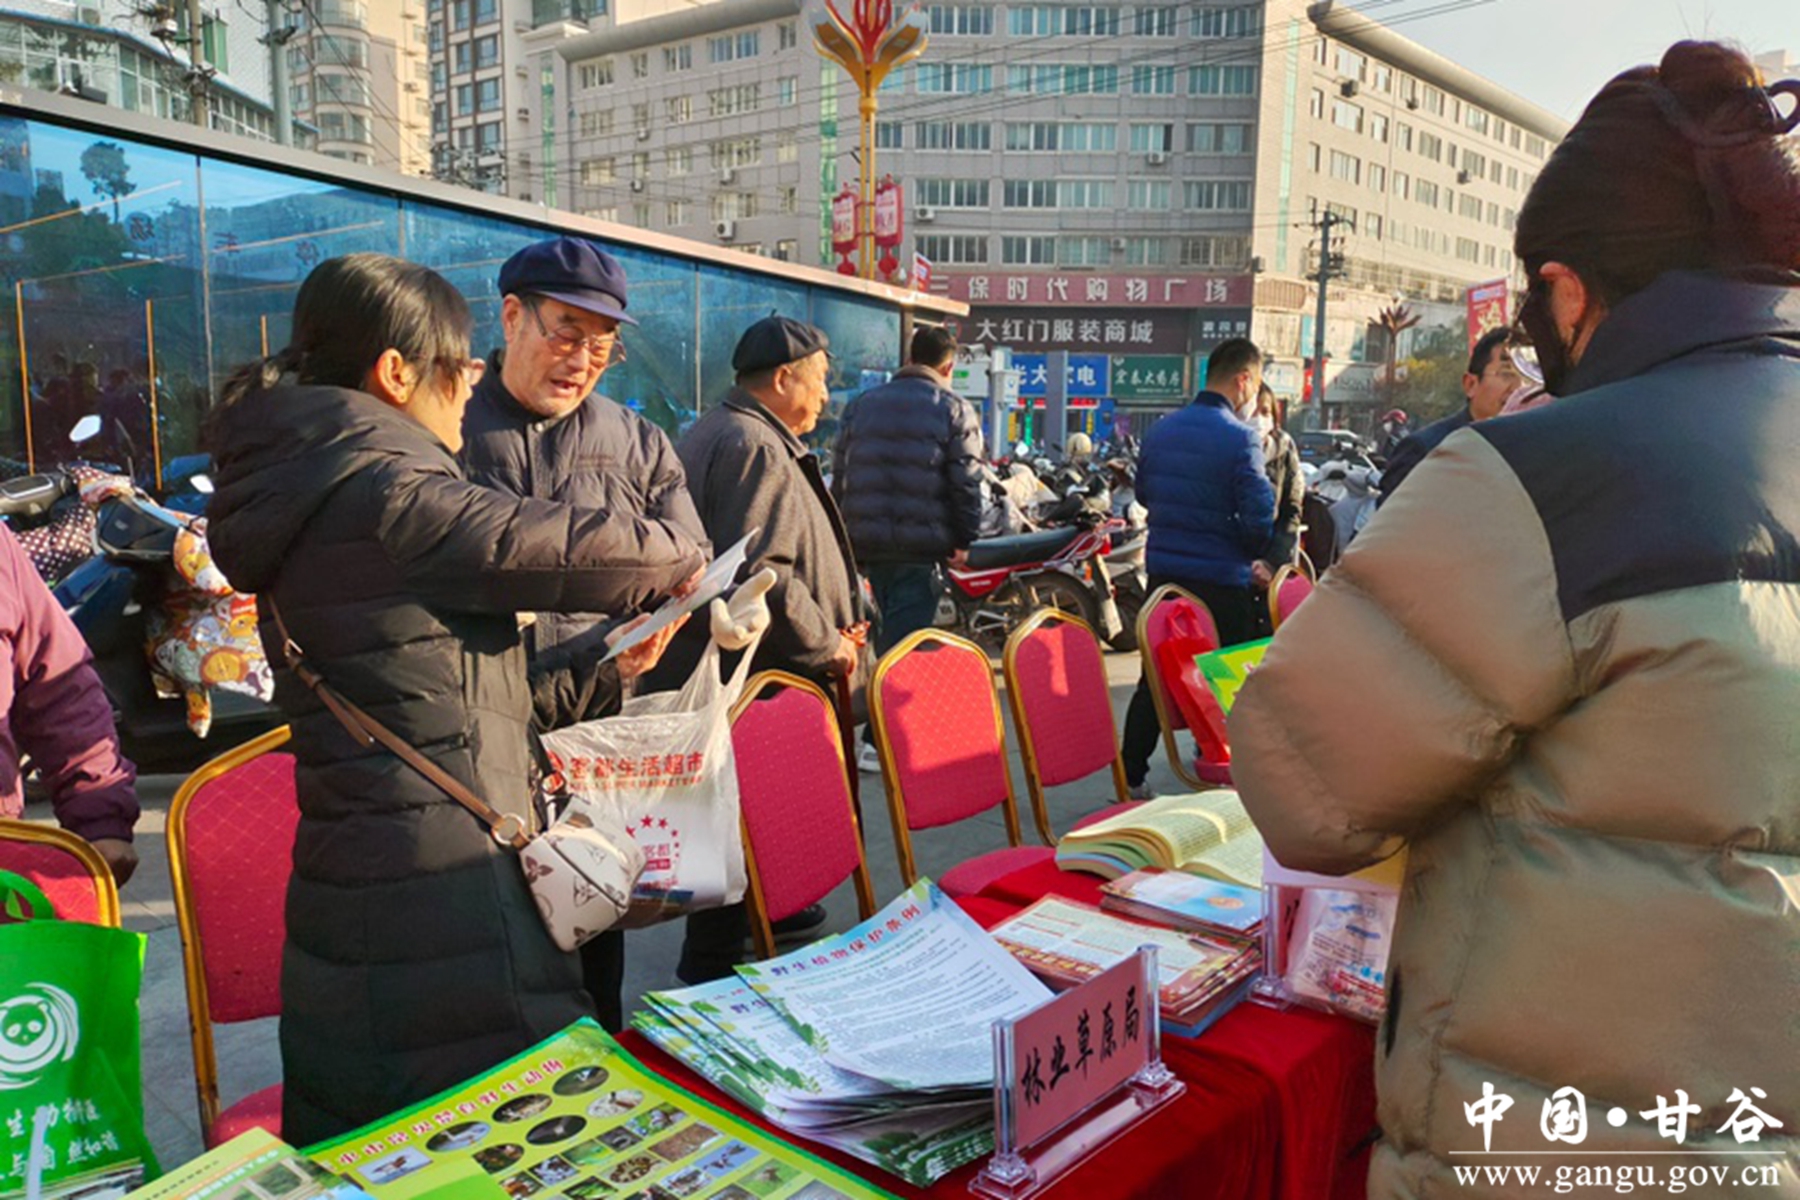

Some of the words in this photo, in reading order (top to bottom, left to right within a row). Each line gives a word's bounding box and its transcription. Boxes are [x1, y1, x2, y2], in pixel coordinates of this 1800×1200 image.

[929, 275, 1229, 303] 三保时代购物广场
[975, 318, 1154, 344] 大红门服装商城
[1021, 985, 1140, 1109] 林业草原局
